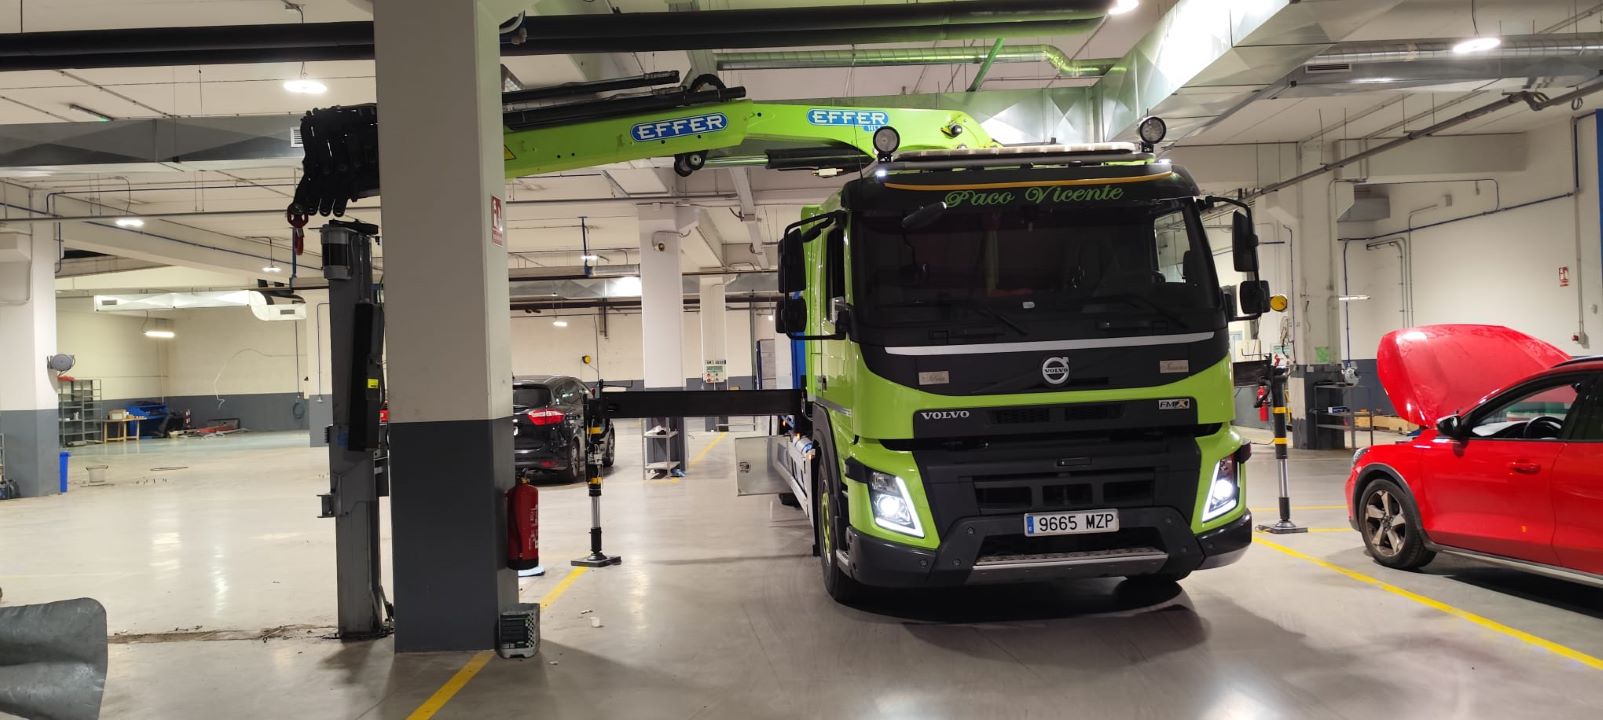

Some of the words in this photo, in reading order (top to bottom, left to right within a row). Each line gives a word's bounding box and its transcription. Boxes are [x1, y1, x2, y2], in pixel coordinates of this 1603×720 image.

[812, 111, 885, 125] EFFER
[638, 115, 723, 139] EFFER
[945, 190, 1015, 208] Paco
[1025, 184, 1124, 204] Vicente
[1160, 399, 1189, 408] FMX
[921, 410, 970, 420] VOLVO
[1039, 515, 1078, 532] 9665
[1086, 513, 1114, 529] MZP
